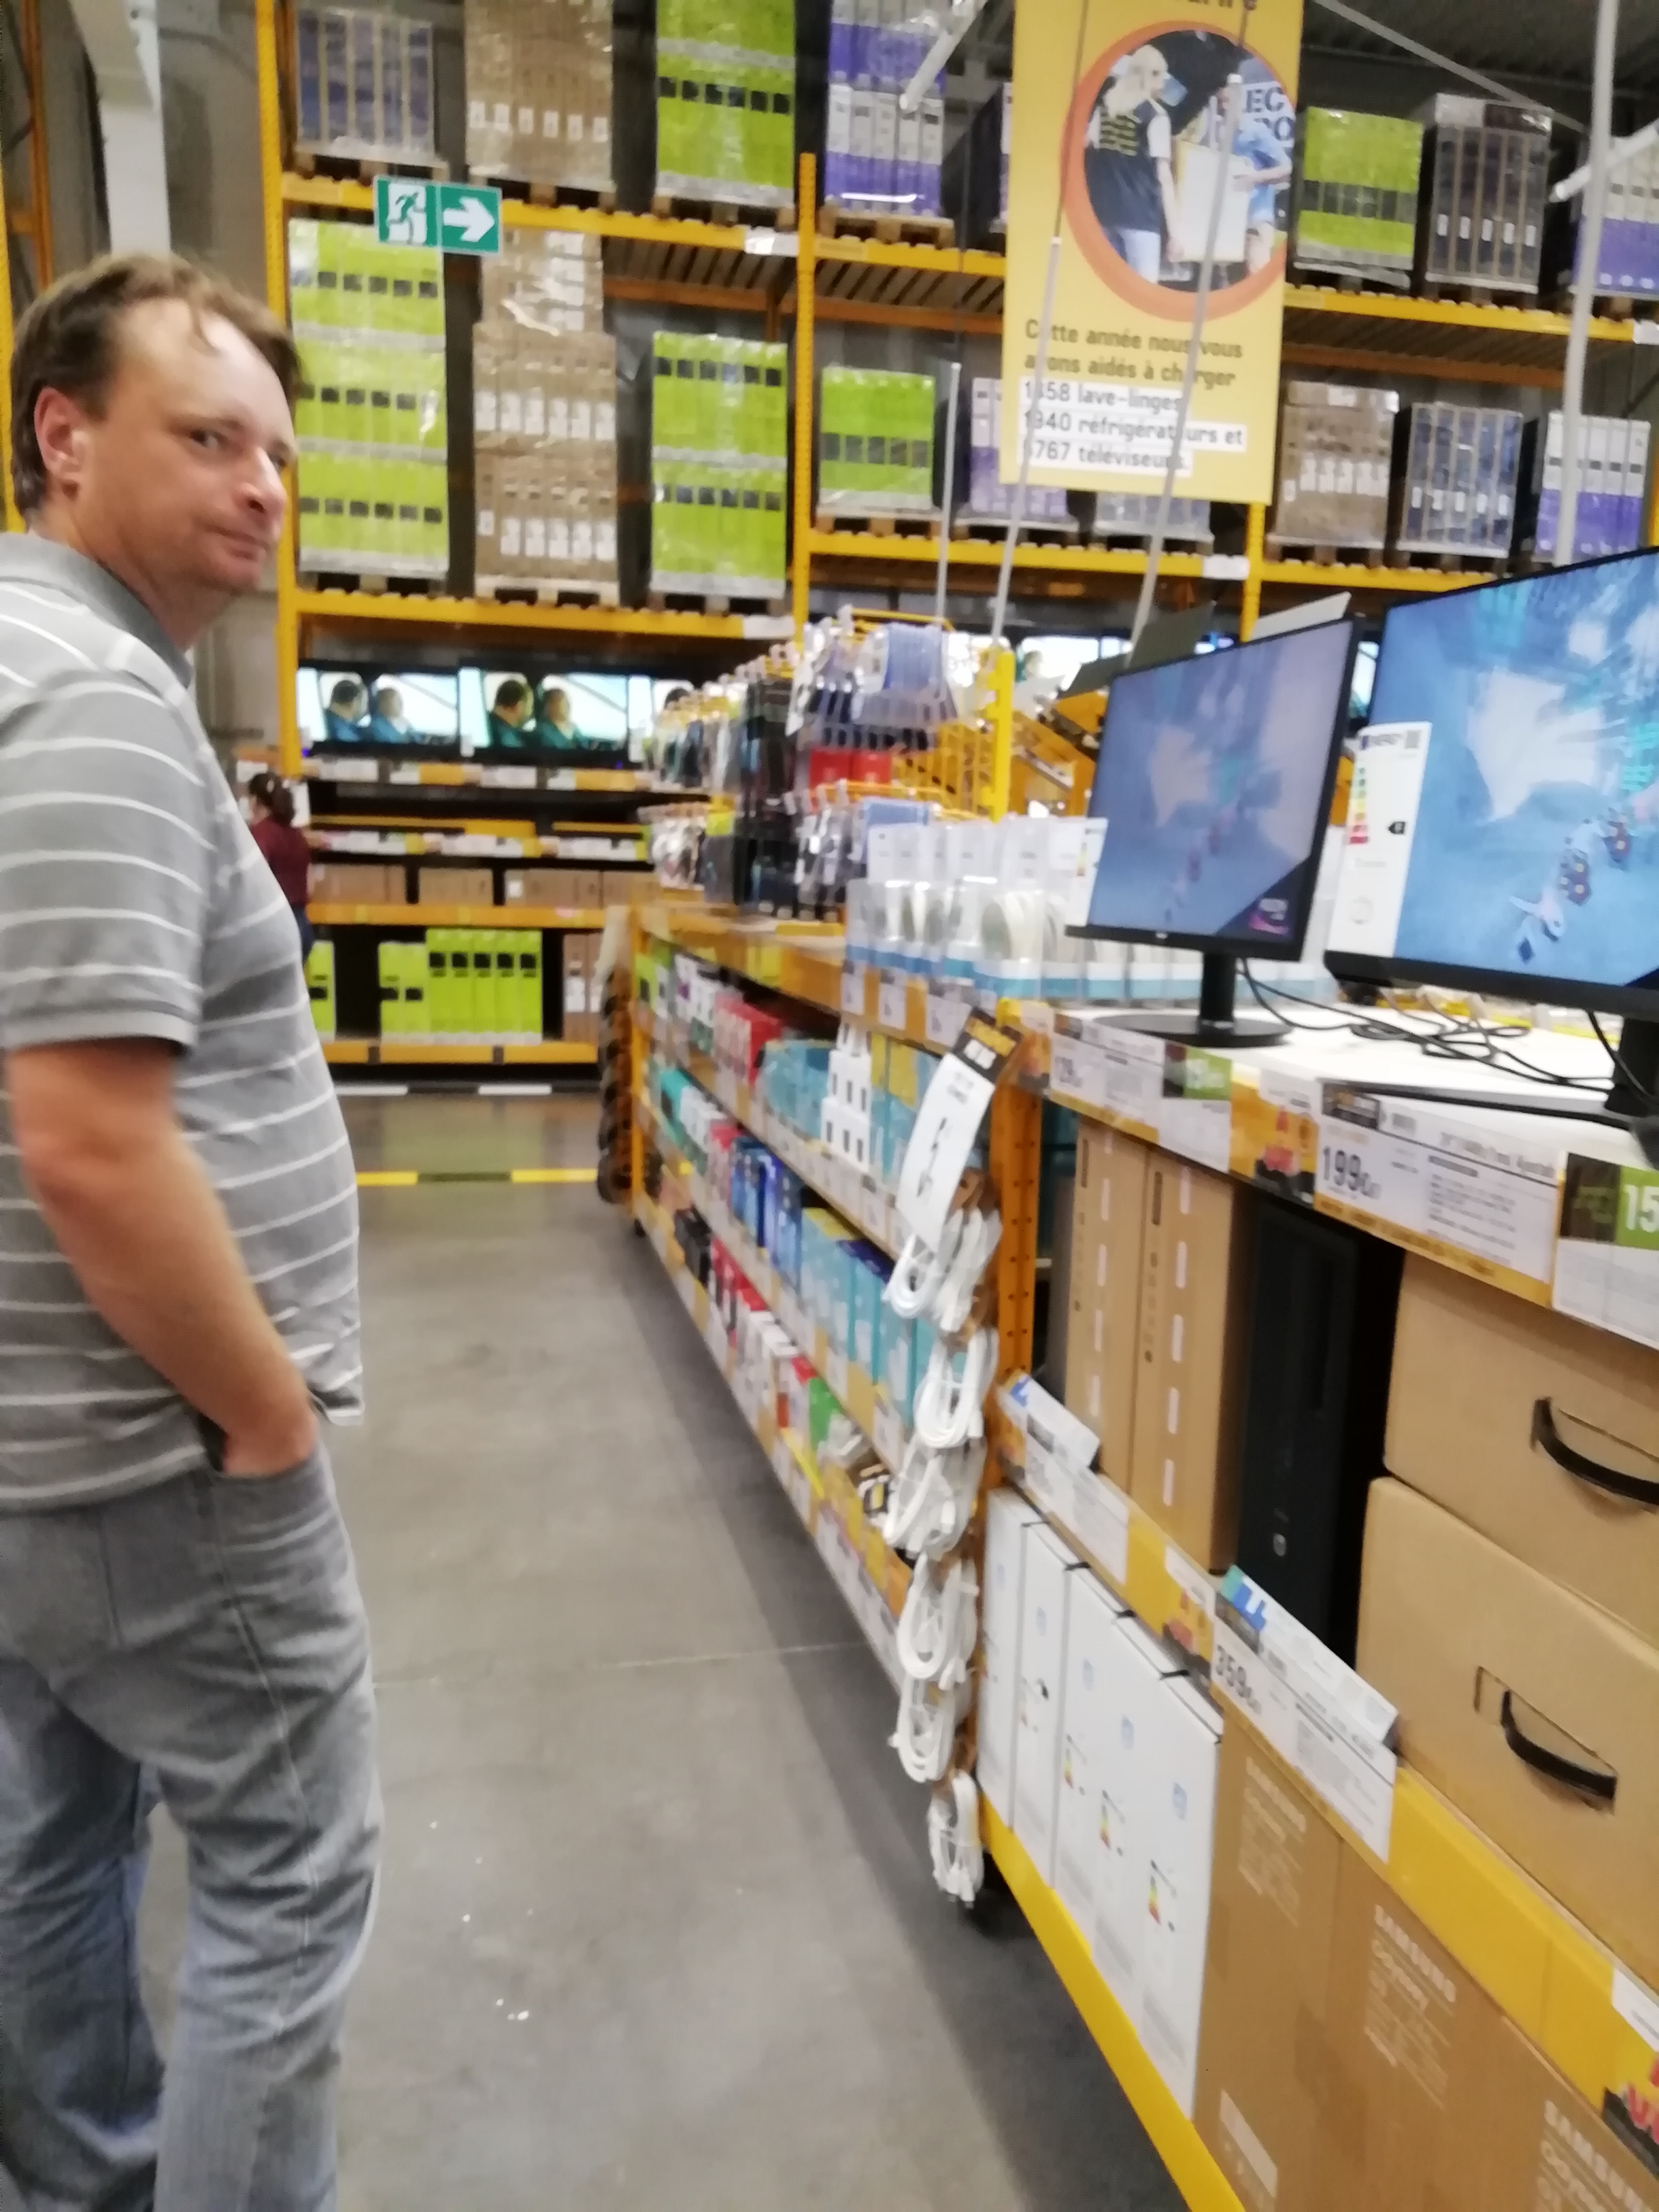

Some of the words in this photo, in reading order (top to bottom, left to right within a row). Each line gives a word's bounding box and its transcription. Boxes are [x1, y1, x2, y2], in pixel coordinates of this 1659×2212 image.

[1026, 319, 1078, 343] Ctte
[1087, 328, 1142, 349] année
[1199, 341, 1242, 358] vous
[1025, 355, 1080, 373] aons
[1144, 360, 1154, 380] à
[1161, 362, 1236, 390] chrger
[1079, 416, 1217, 442] réfrigératurs
[1226, 430, 1242, 444] et
[1024, 438, 1070, 460] 767
